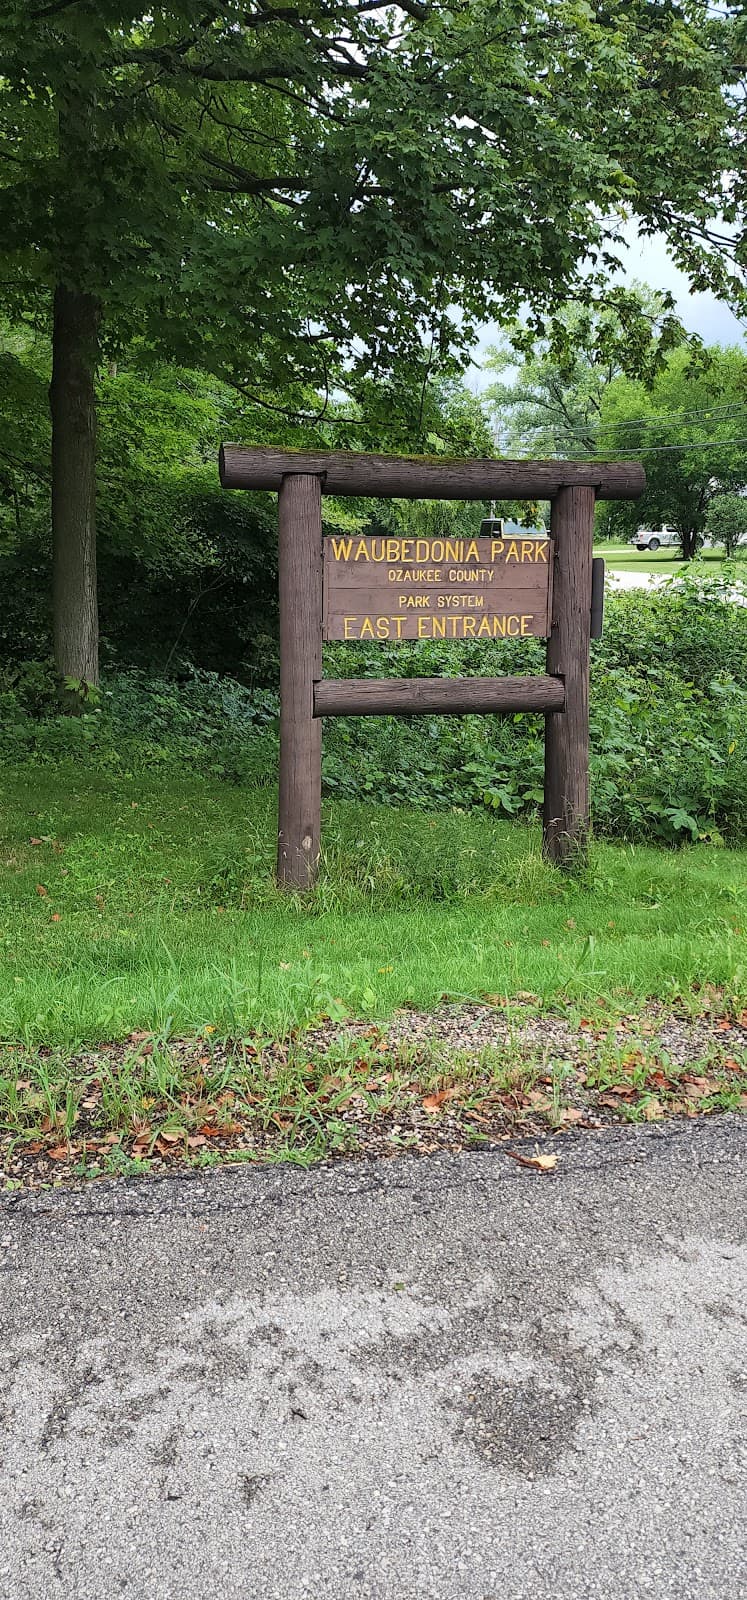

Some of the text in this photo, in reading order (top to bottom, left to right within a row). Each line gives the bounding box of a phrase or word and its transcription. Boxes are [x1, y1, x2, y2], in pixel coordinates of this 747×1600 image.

[331, 538, 549, 563] WAUBEDONIA PARK
[388, 569, 495, 582] OZAUKEE COUNTY
[399, 595, 484, 608] PARK SYSTEM
[344, 615, 534, 639] EAST ENTRANCE
